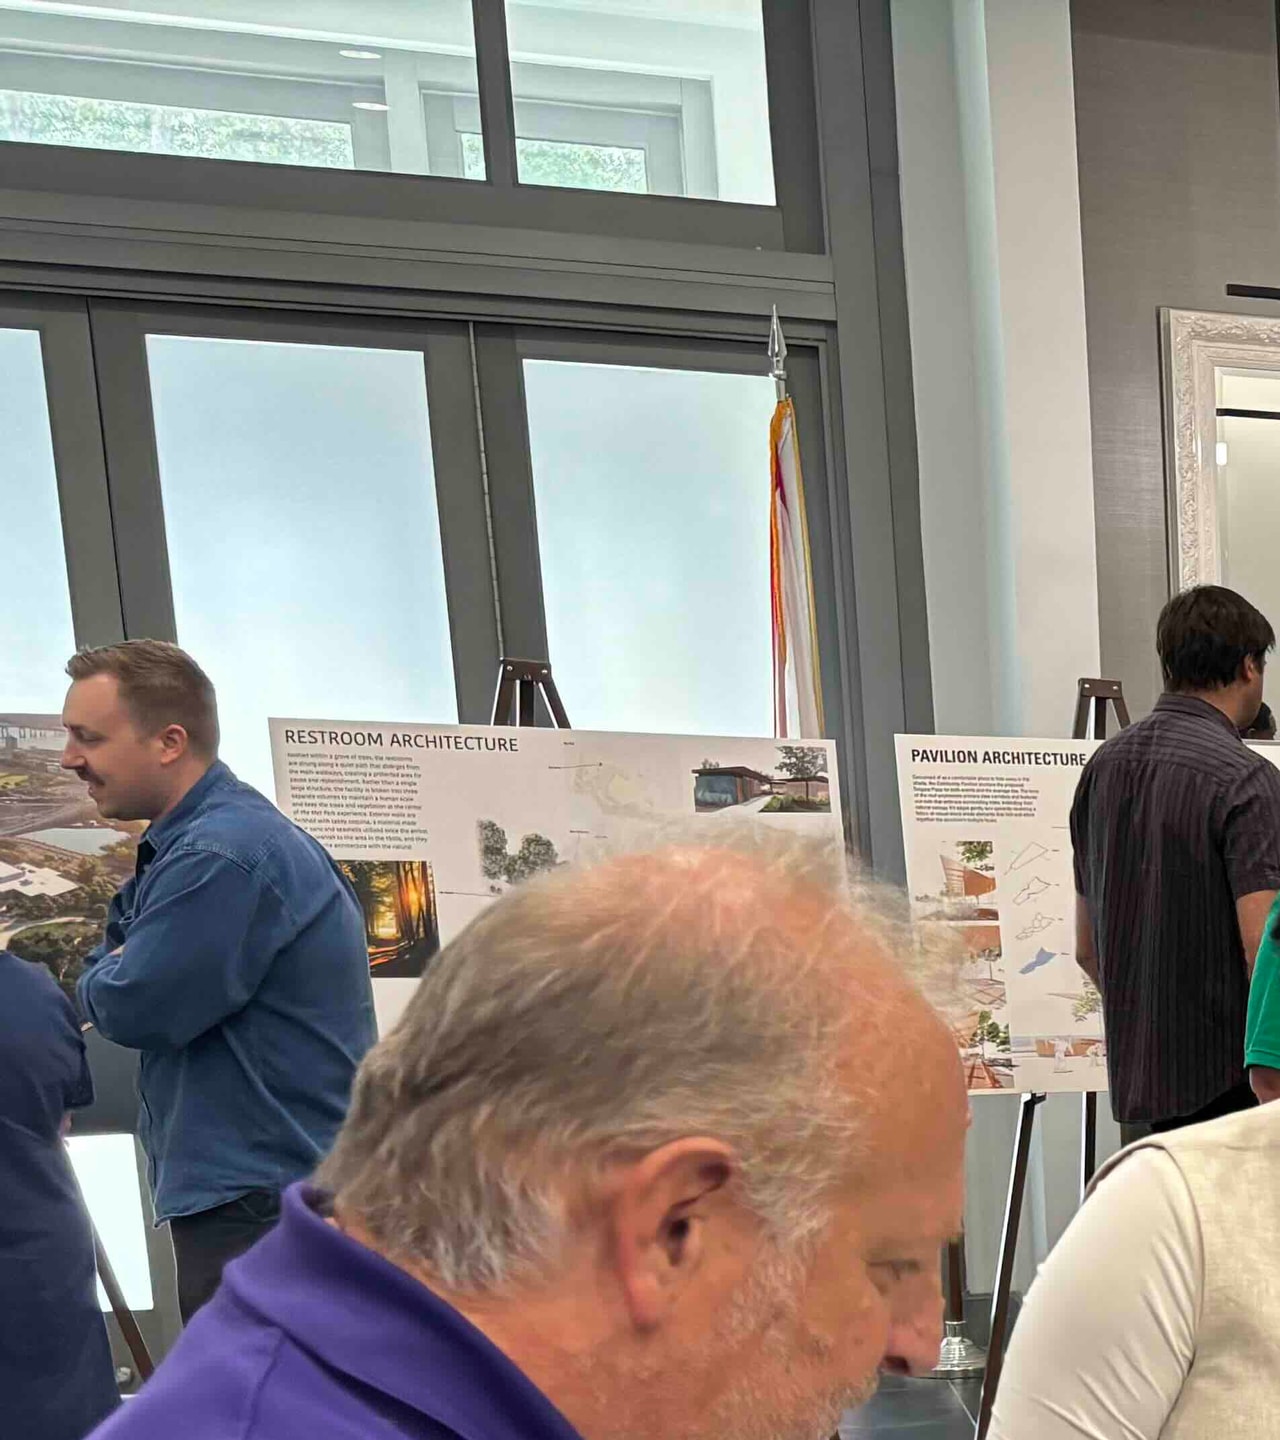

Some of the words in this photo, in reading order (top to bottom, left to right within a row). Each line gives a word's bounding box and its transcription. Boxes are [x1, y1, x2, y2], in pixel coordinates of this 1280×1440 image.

[285, 729, 383, 747] RESTROOM
[390, 733, 519, 752] ARCHITECTURE
[911, 749, 977, 763] PAVILION
[982, 751, 1086, 766] ARCHITECTURE
